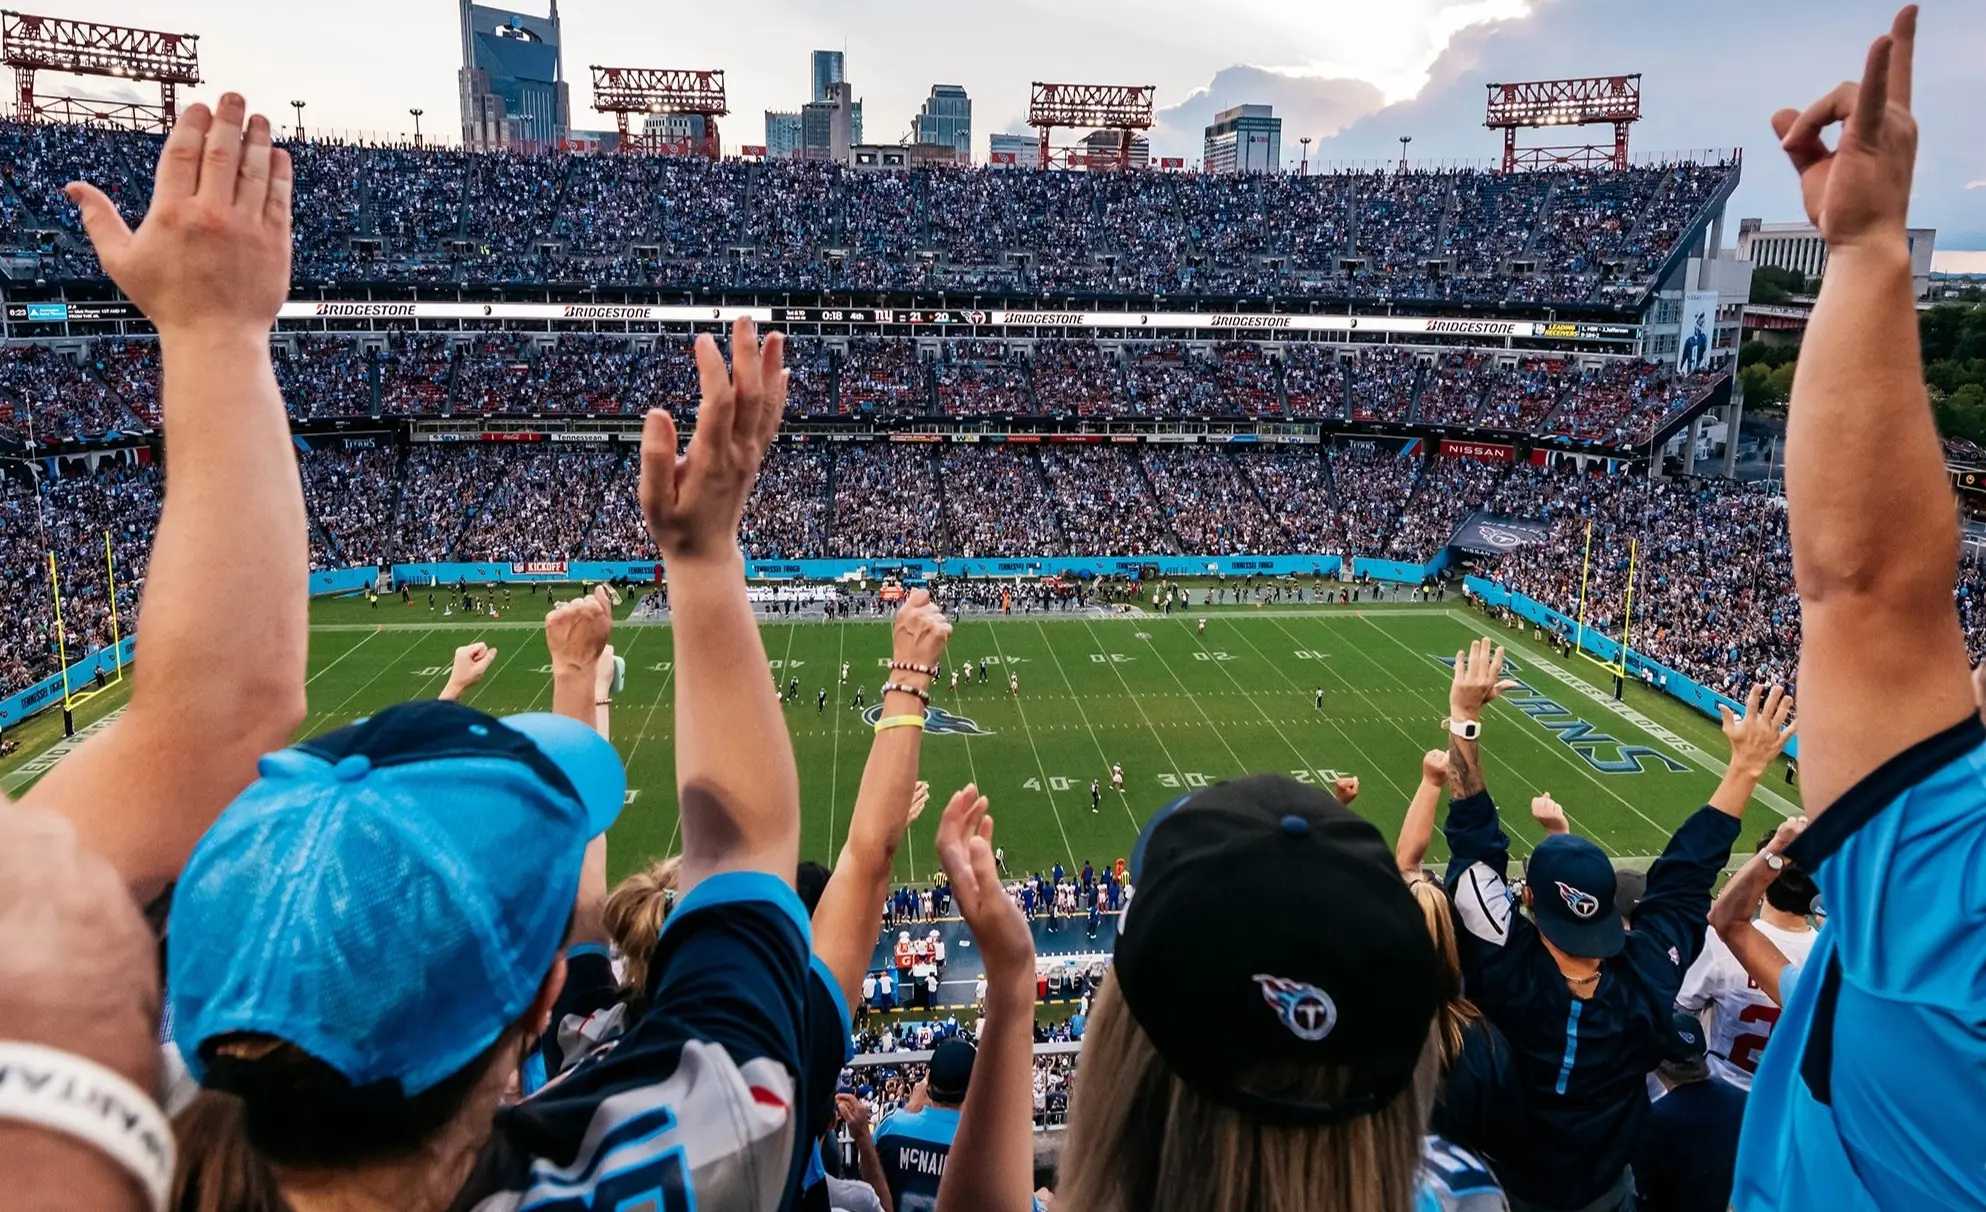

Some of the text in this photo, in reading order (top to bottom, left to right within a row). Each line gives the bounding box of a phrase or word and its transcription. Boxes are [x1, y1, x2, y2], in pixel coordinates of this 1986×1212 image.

[316, 303, 416, 316] BRIDGESTONE
[564, 305, 651, 318] BRIDGESTONE
[822, 311, 842, 322] 0:18
[850, 314, 864, 322] 4th
[909, 312, 921, 321] 21
[934, 312, 949, 321] 20
[1003, 311, 1084, 324] BRIDGESTONE
[1211, 315, 1291, 327] BRIDGESTONE
[1425, 320, 1515, 334] BRIDGESTONE
[1348, 440, 1376, 450] TITANS
[1449, 445, 1504, 457] NISSAN
[1461, 547, 1491, 556] NISSAN
[528, 562, 562, 572] KICKOFF
[1635, 720, 1665, 732] OF
[1663, 736, 1695, 751] US
[21, 749, 70, 772] END
[1157, 773, 1208, 787] 30
[1290, 769, 1340, 784] 20
[1023, 777, 1070, 791] 40
